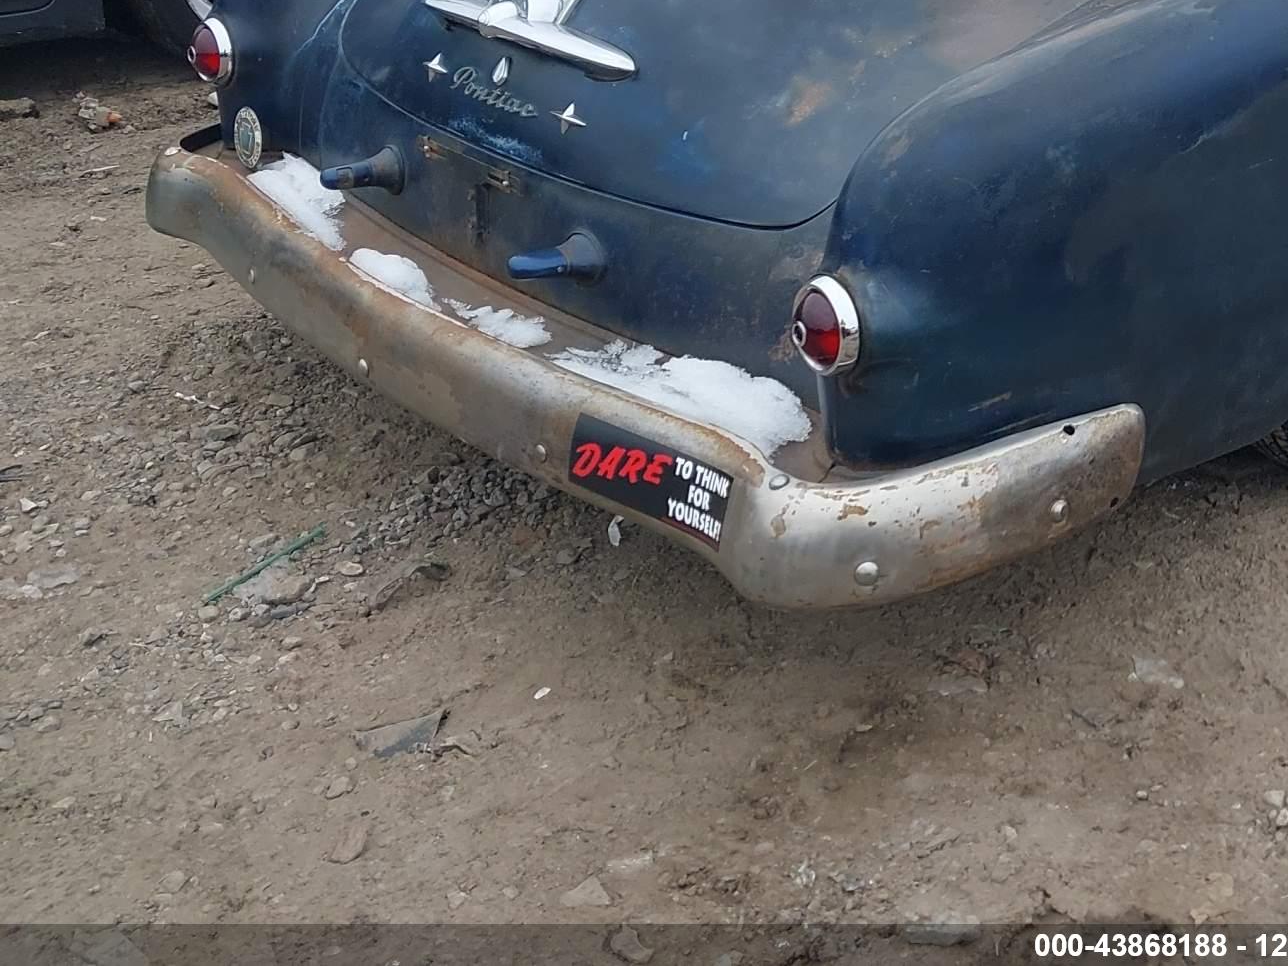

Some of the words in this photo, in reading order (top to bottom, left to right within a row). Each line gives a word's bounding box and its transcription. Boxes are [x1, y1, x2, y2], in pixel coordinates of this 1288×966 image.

[449, 66, 539, 117] Pontiac
[572, 441, 674, 485] DARE
[675, 456, 693, 480] TO
[694, 465, 730, 499] THINK
[667, 497, 722, 542] YOURSELF!
[687, 484, 710, 511] FOR
